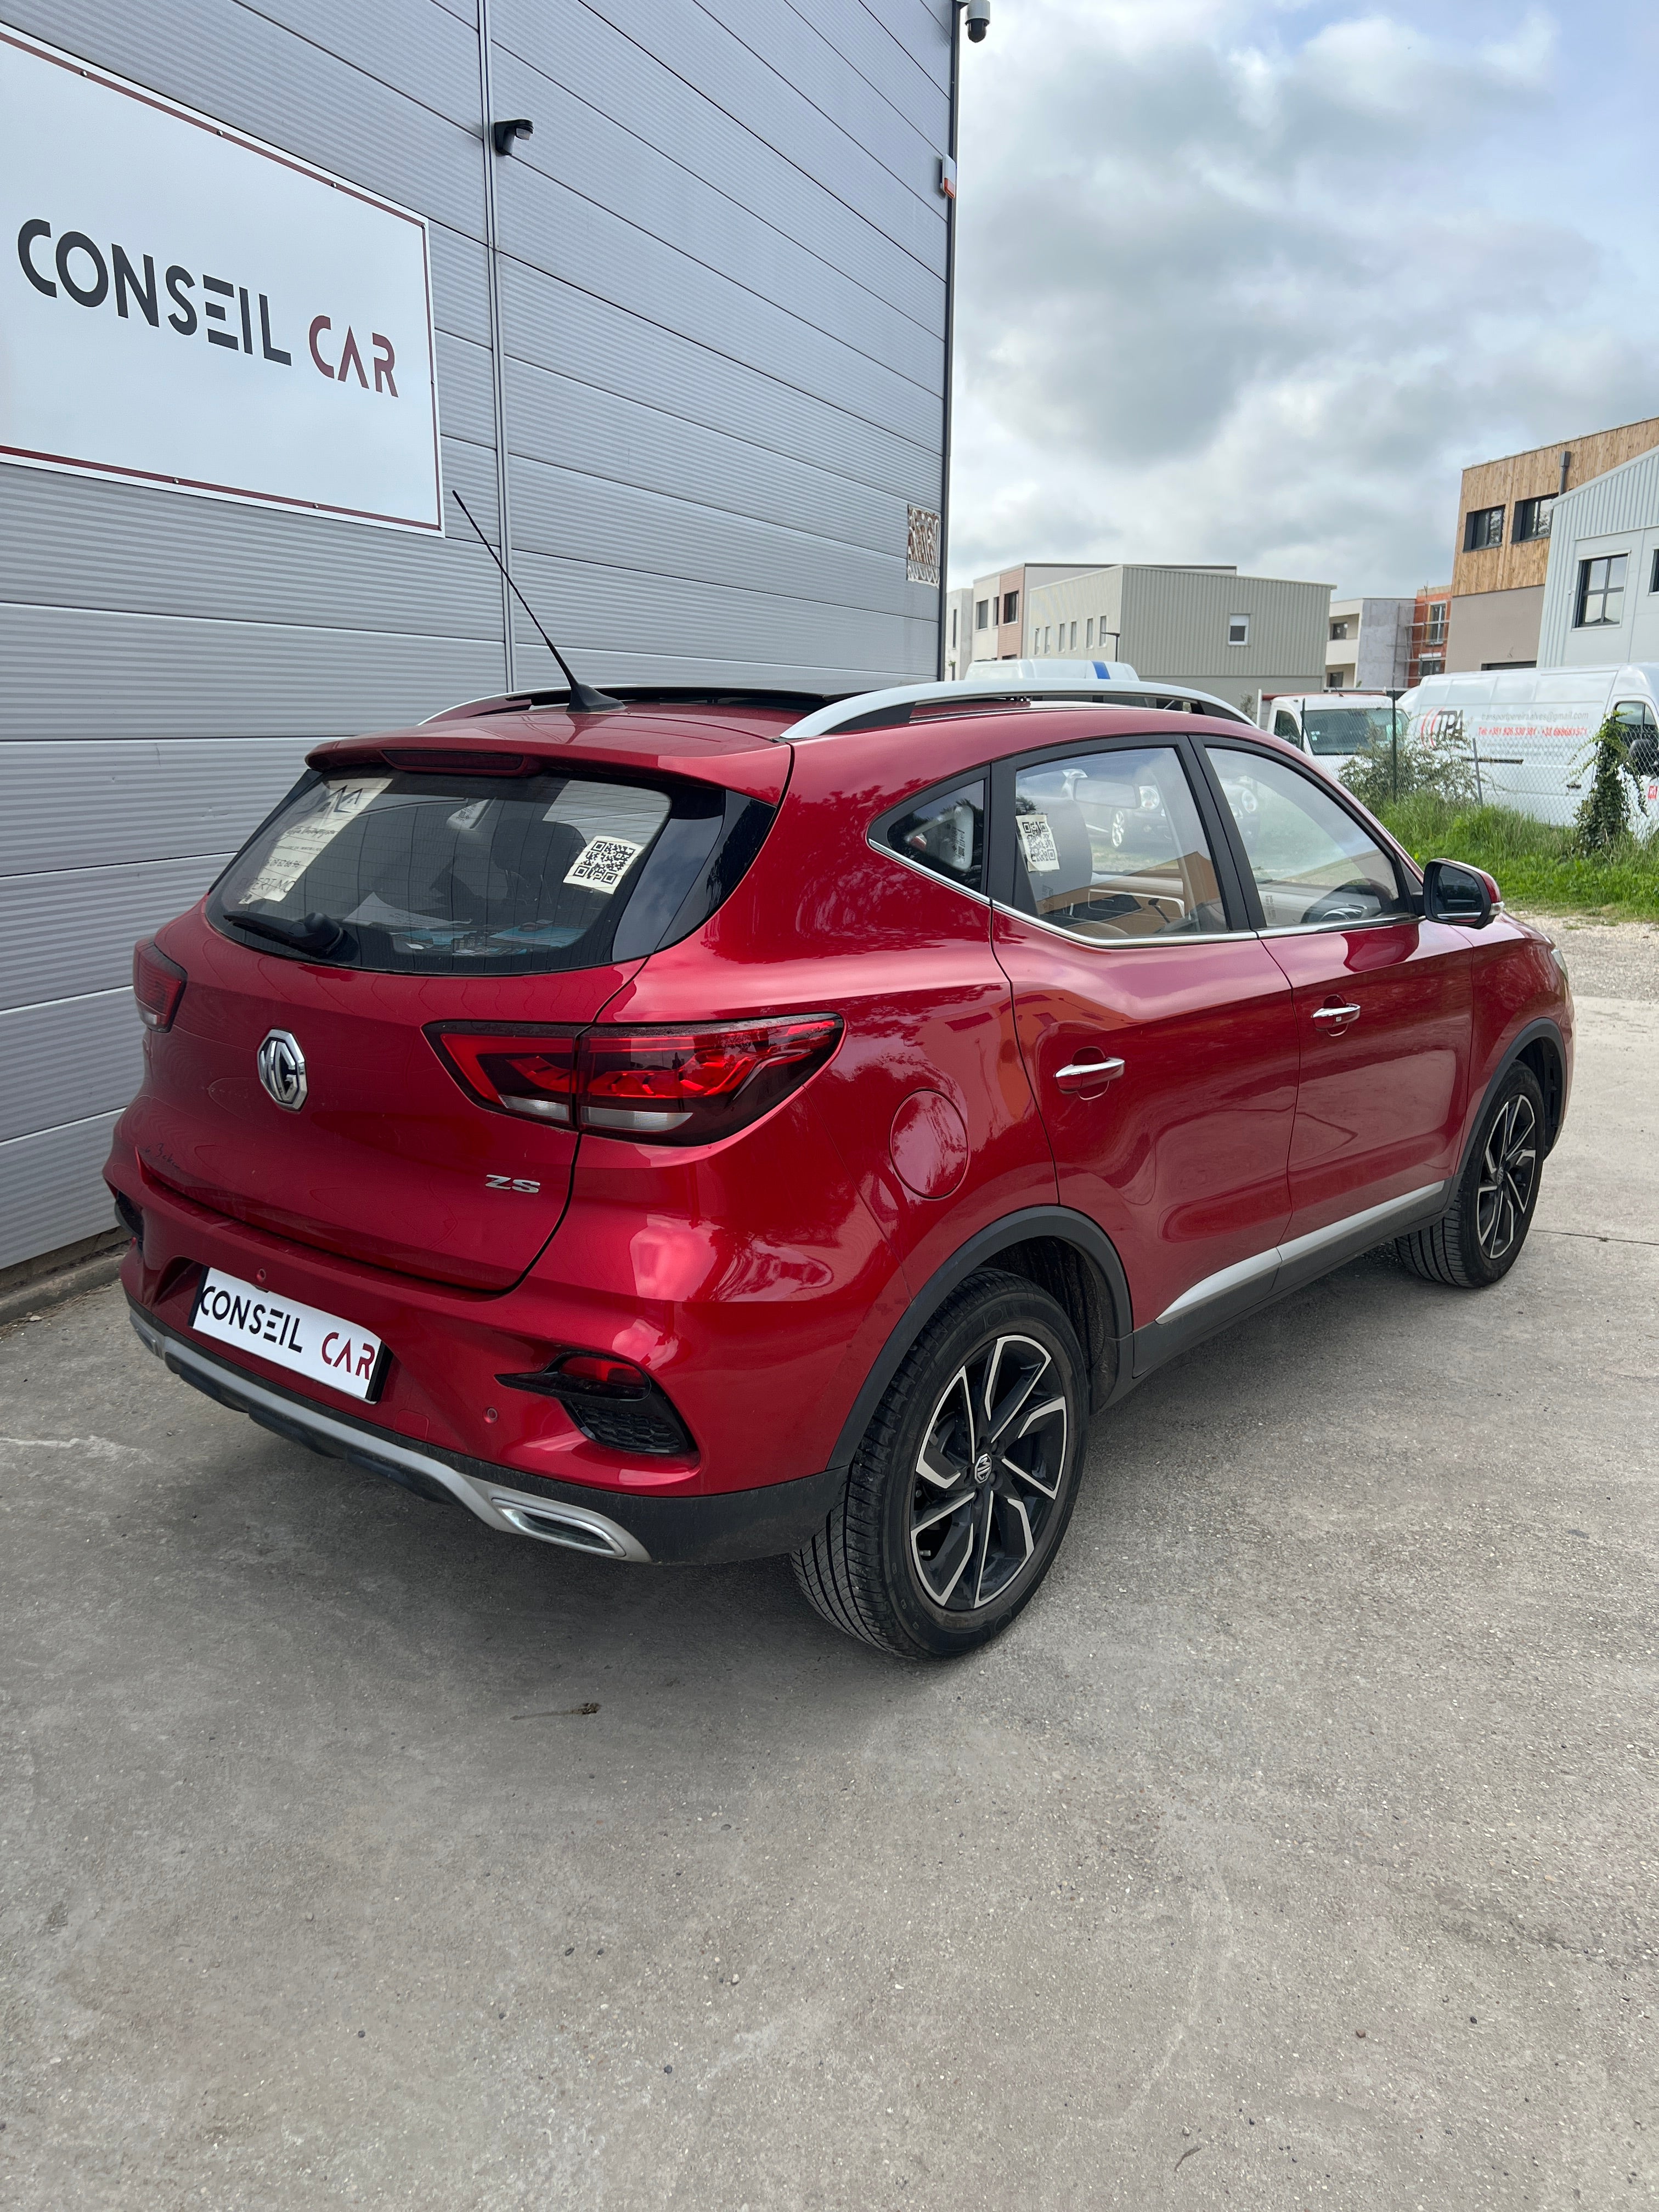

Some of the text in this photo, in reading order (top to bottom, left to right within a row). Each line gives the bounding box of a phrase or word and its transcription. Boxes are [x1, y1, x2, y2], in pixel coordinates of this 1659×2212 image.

[18, 219, 398, 398] CONSEIL CAR
[485, 1174, 540, 1193] ZS
[201, 1286, 375, 1380] CONSEIL CAR
